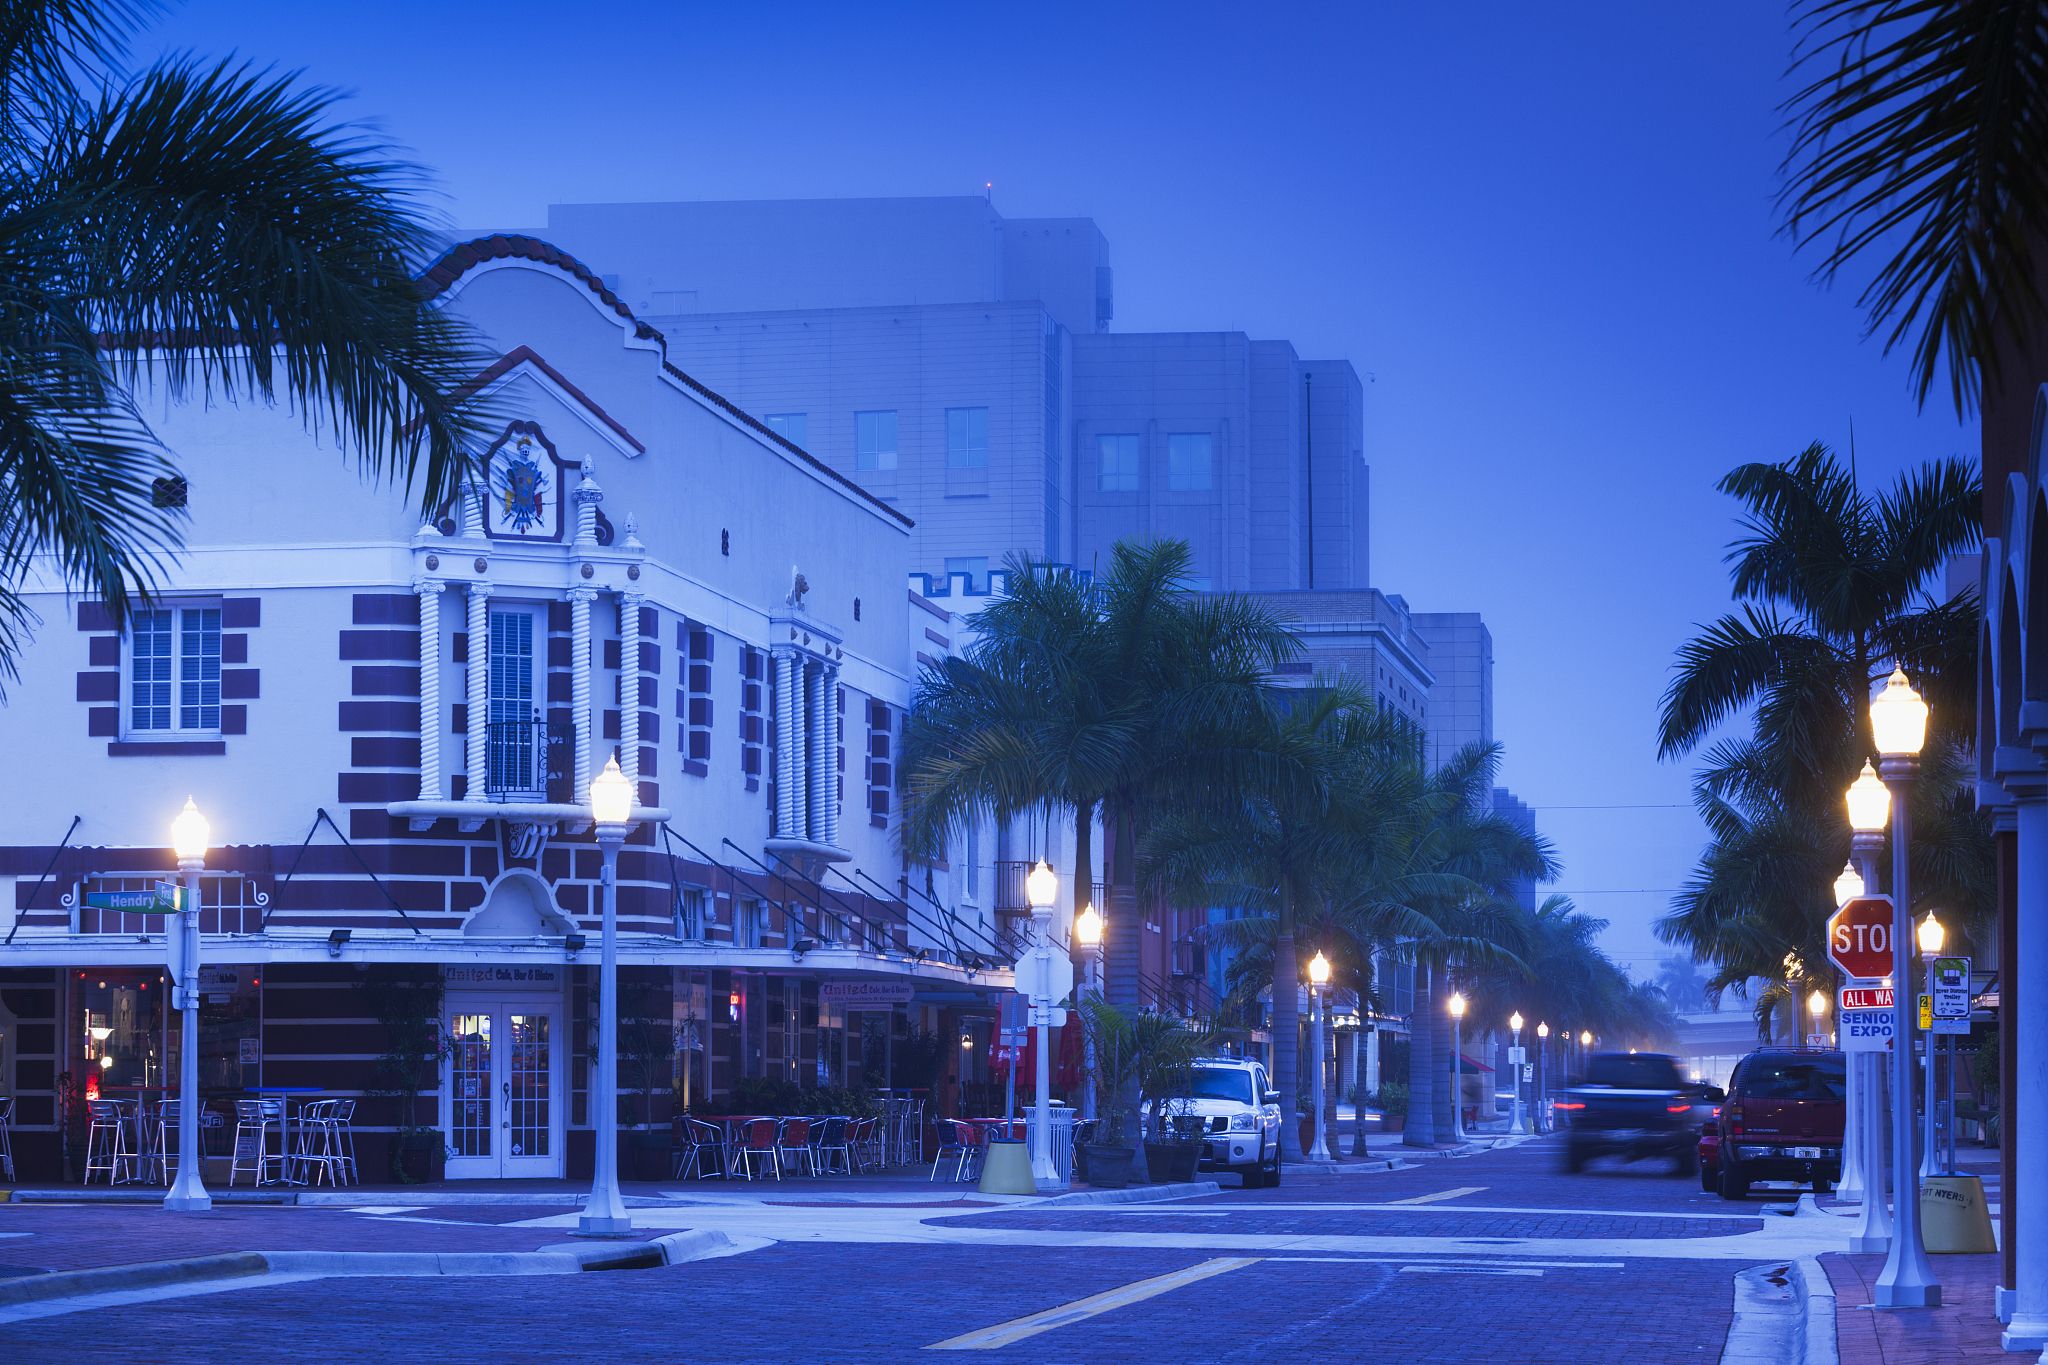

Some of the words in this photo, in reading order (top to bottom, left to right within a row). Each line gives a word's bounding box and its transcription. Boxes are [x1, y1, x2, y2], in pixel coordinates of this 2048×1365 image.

[161, 886, 172, 900] First
[110, 894, 155, 909] Hendry
[1835, 924, 1893, 953] STO
[446, 967, 493, 982] United
[824, 984, 867, 995] United
[869, 985, 881, 994] Cafe,
[882, 985, 891, 994] Bar
[895, 985, 909, 994] Bistro
[1846, 991, 1868, 1007] ALL
[1921, 997, 1926, 1006] 2
[1850, 1026, 1892, 1036] EXPO
